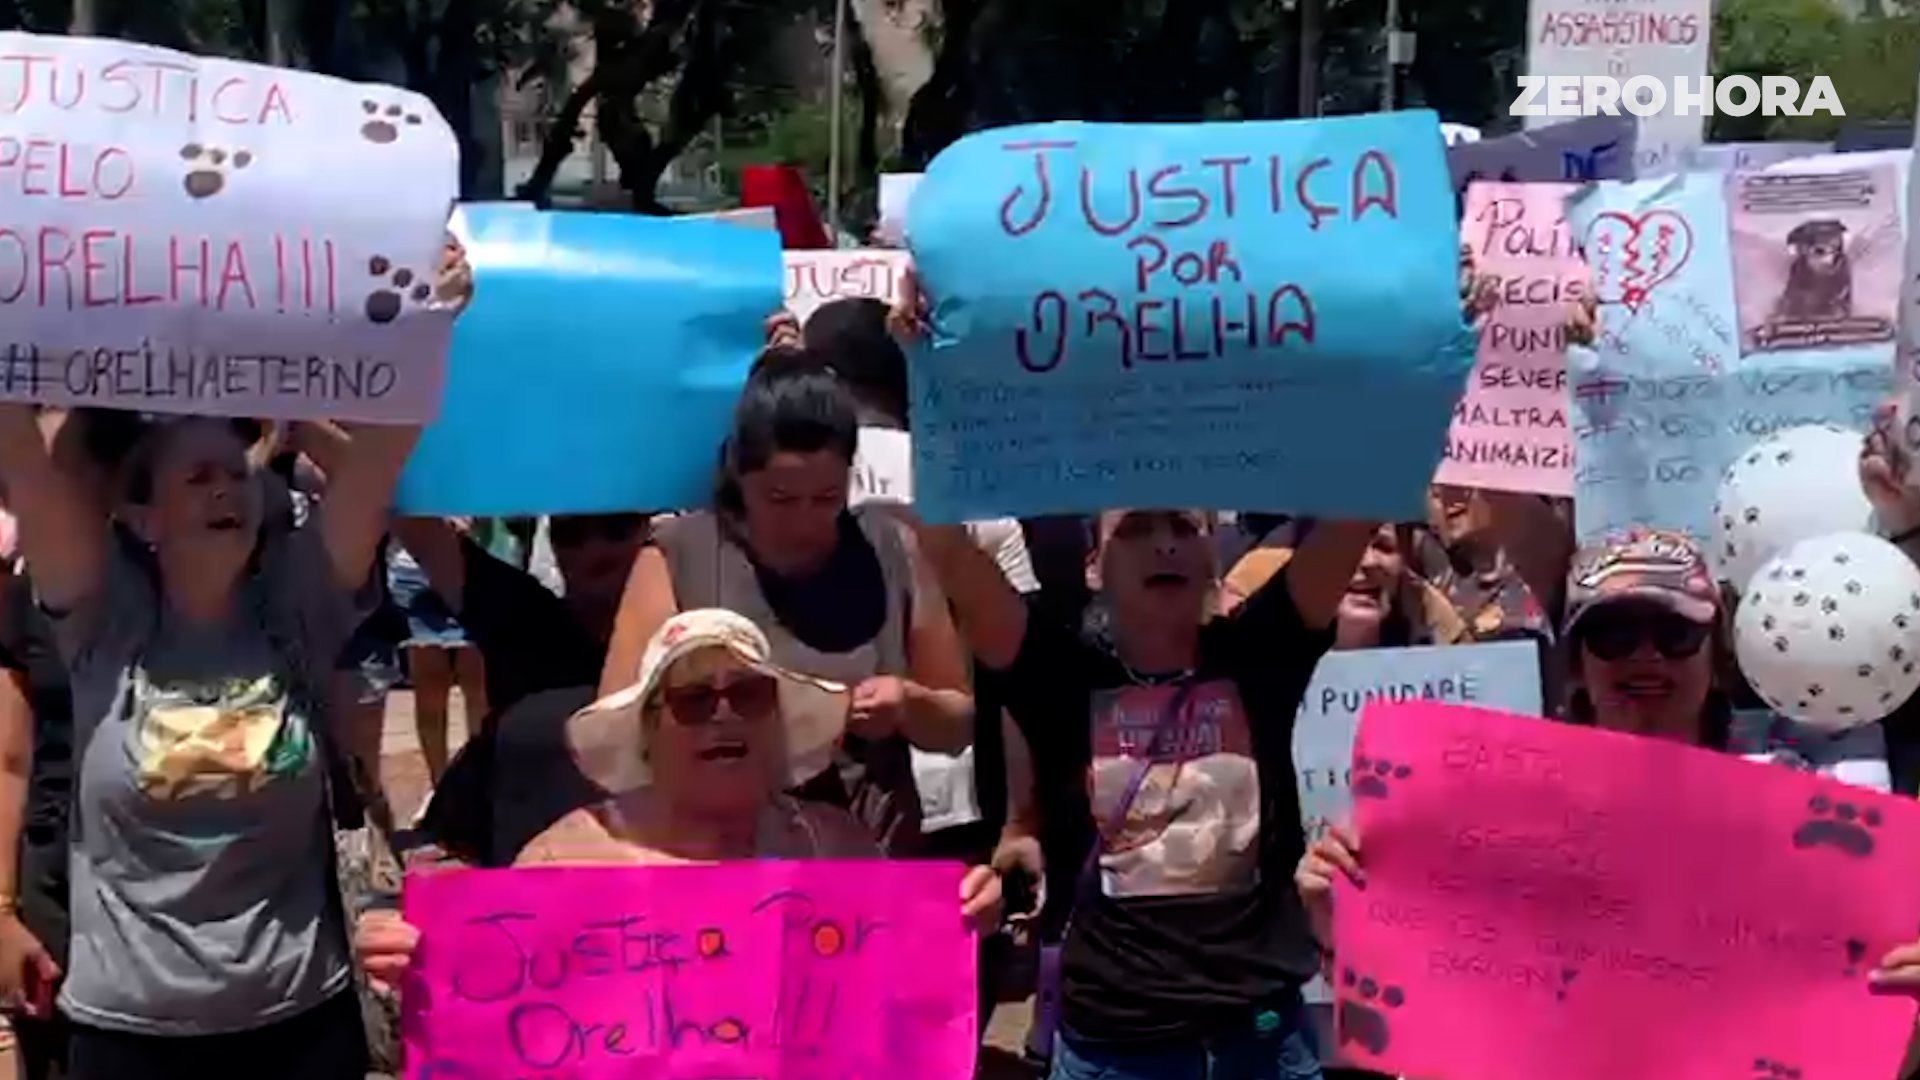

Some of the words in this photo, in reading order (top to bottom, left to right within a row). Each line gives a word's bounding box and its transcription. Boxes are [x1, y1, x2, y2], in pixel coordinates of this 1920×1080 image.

[1541, 12, 1699, 46] ASSASSINOS
[1000, 139, 1399, 236] JUSTIÇA
[1126, 236, 1243, 291] POR
[1015, 284, 1316, 372] ORELHA
